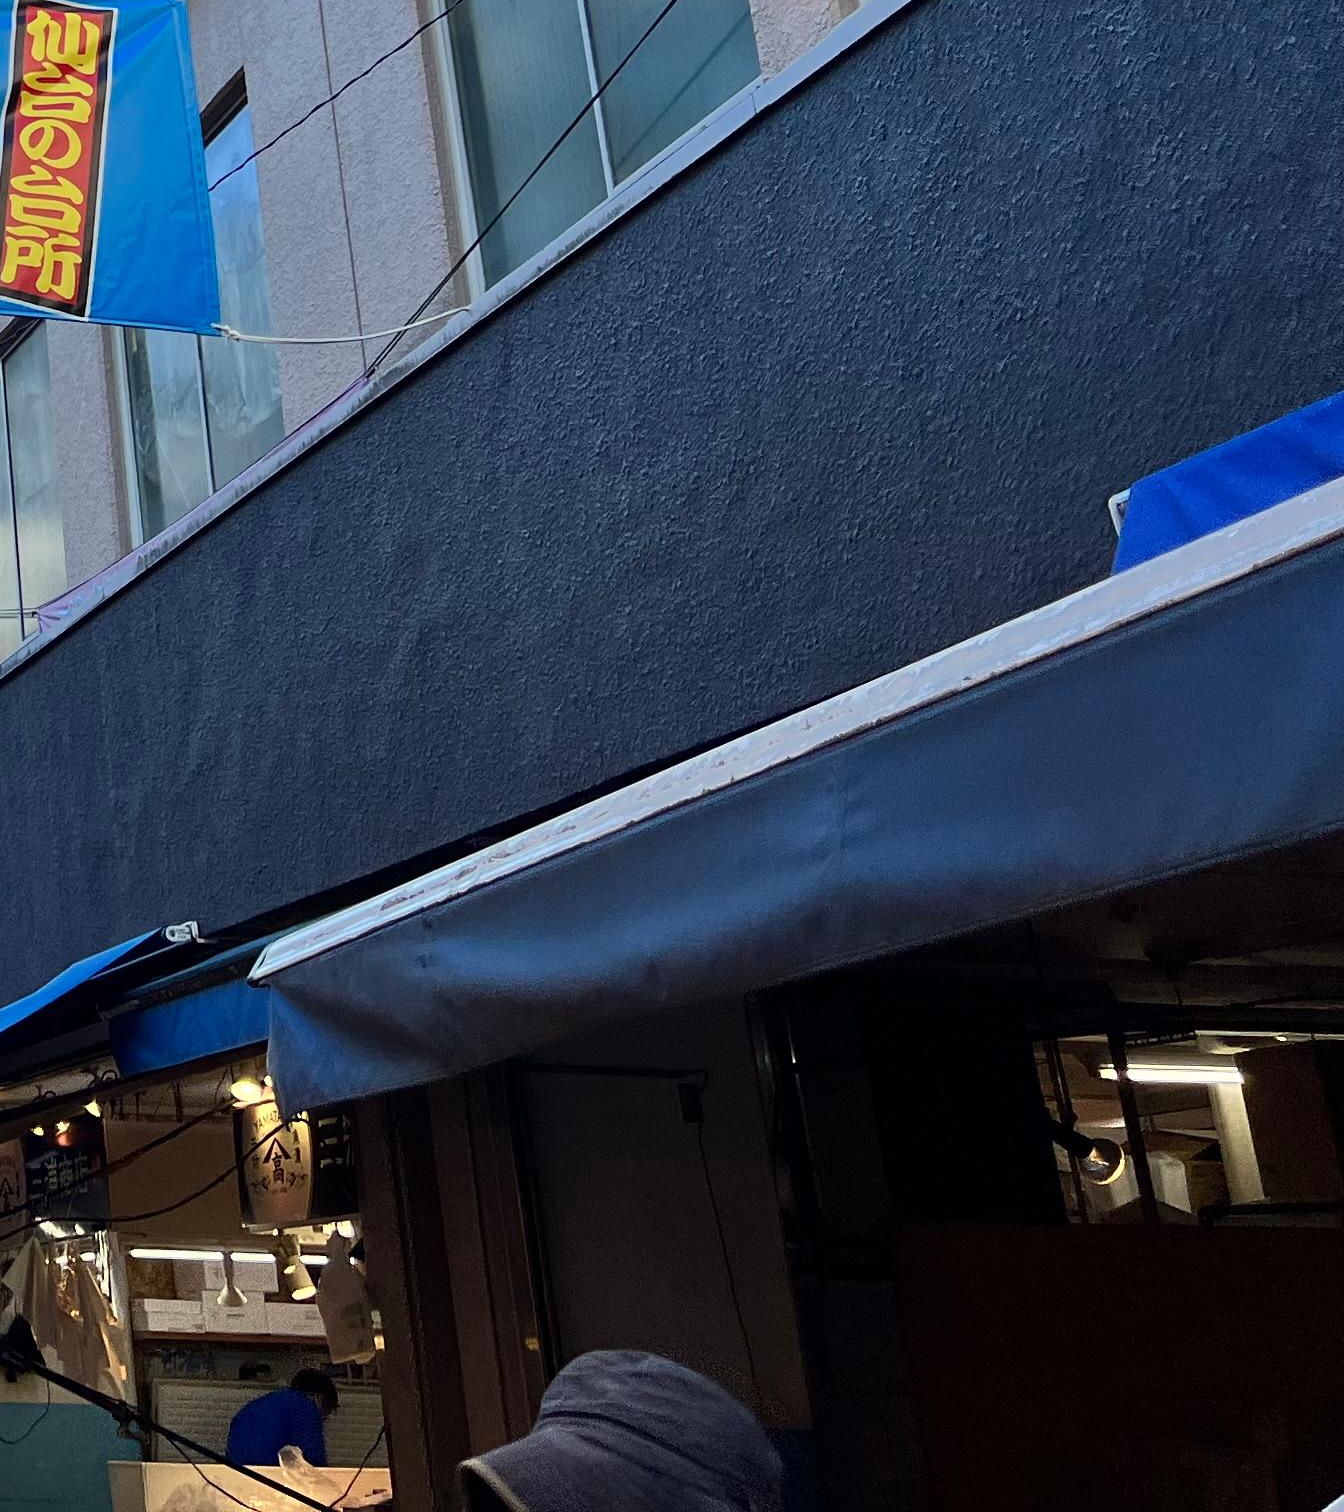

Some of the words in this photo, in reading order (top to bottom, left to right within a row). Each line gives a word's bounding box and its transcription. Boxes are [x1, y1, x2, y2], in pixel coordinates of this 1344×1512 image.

[0, 8, 101, 301] 仙台の台所
